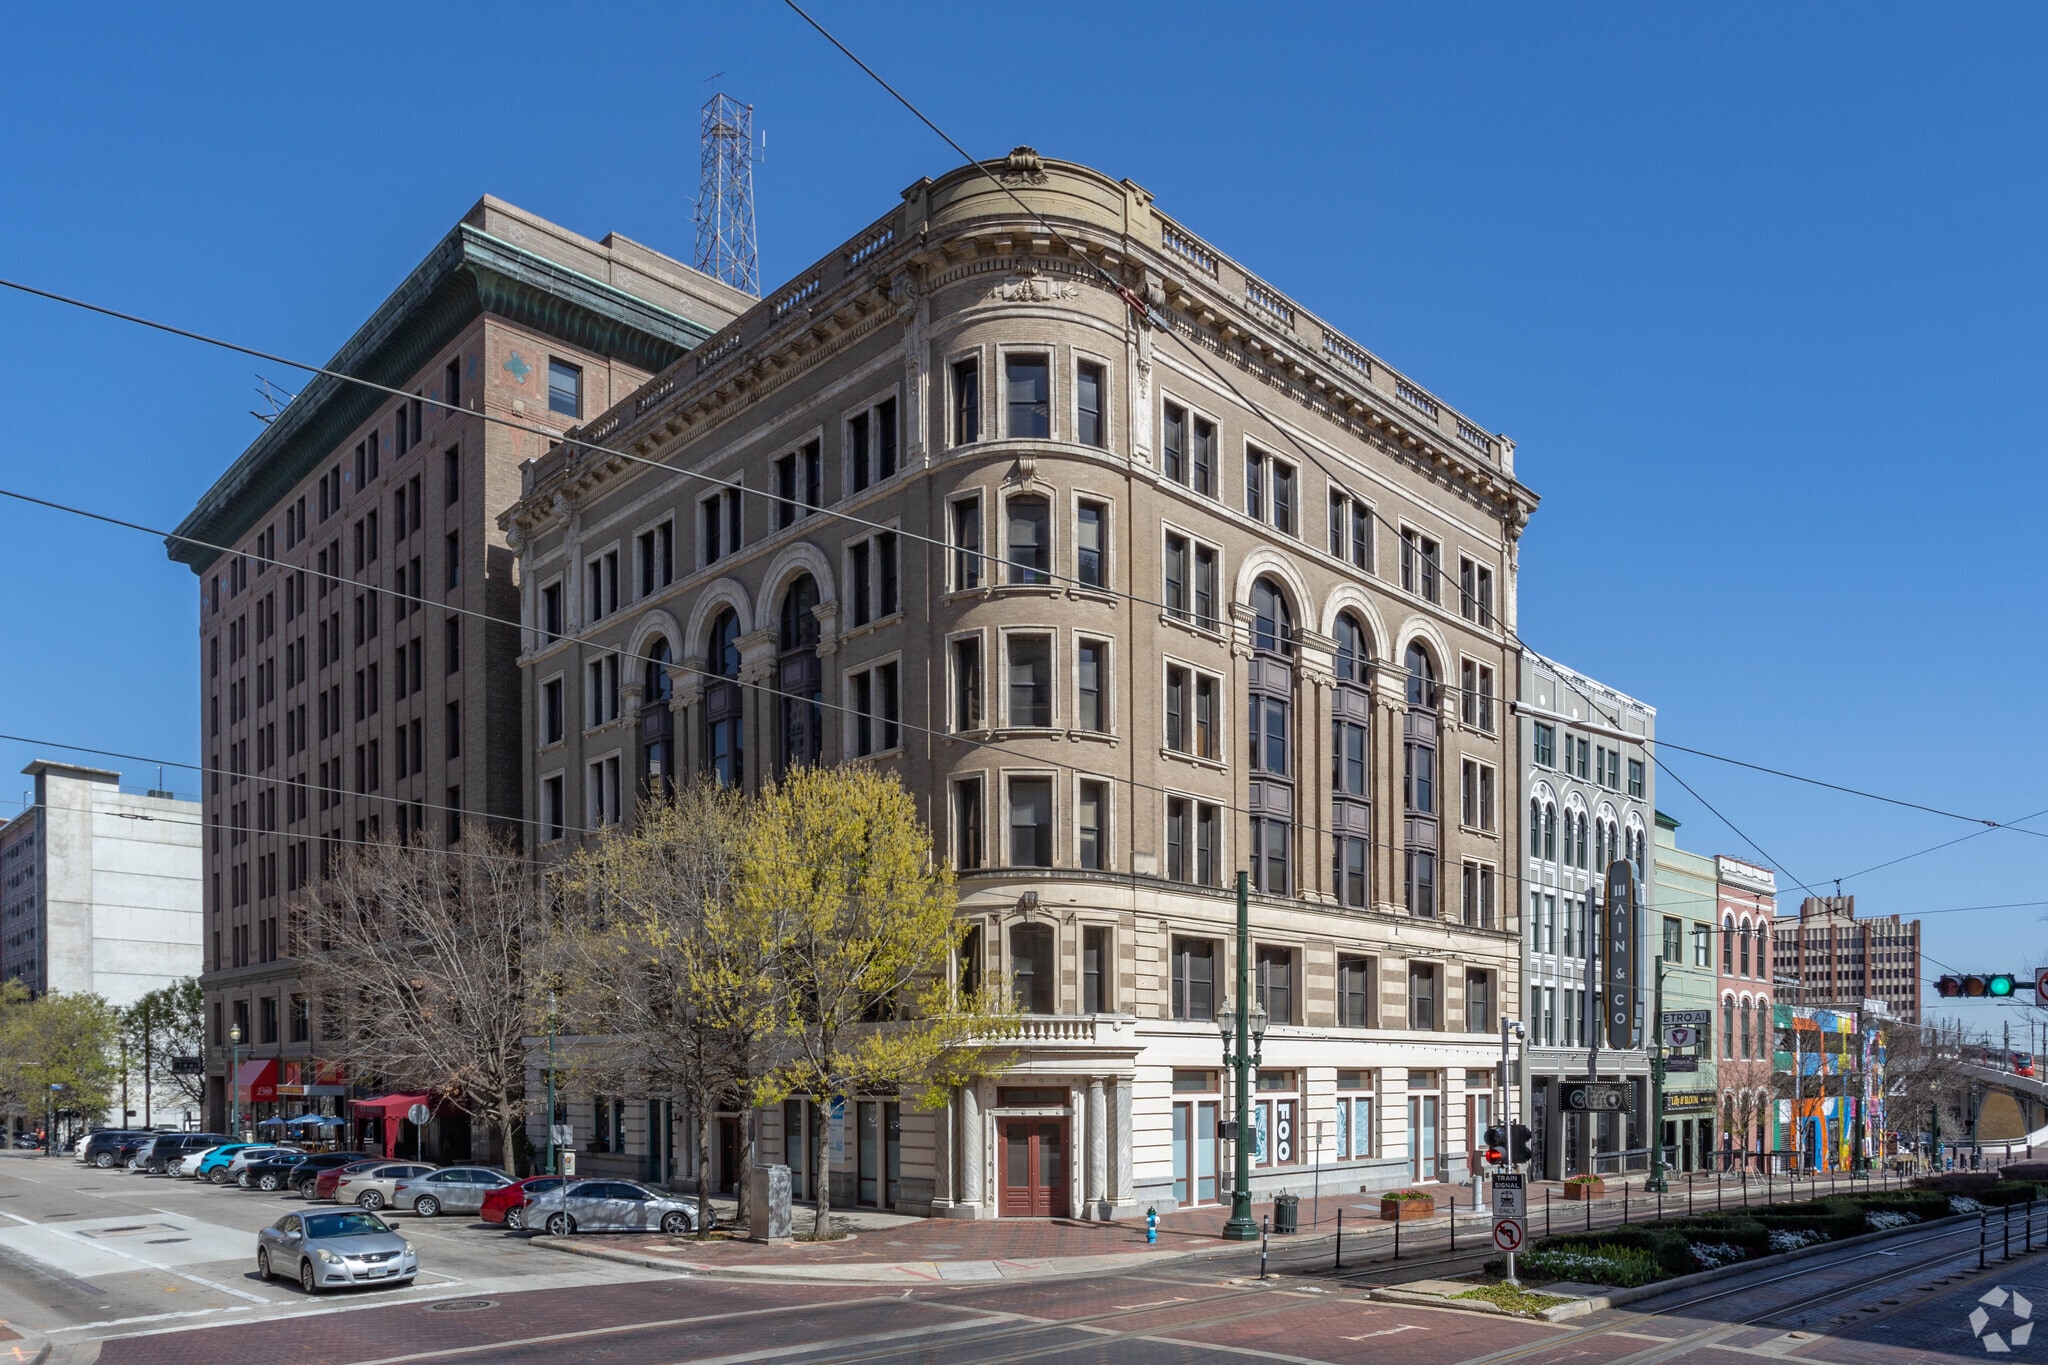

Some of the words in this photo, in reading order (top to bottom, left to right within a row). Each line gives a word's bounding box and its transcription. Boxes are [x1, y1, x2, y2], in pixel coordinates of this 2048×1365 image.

[1615, 967, 1625, 979] &
[1614, 994, 1626, 1024] CO
[1663, 1013, 1705, 1022] ETRO.AI
